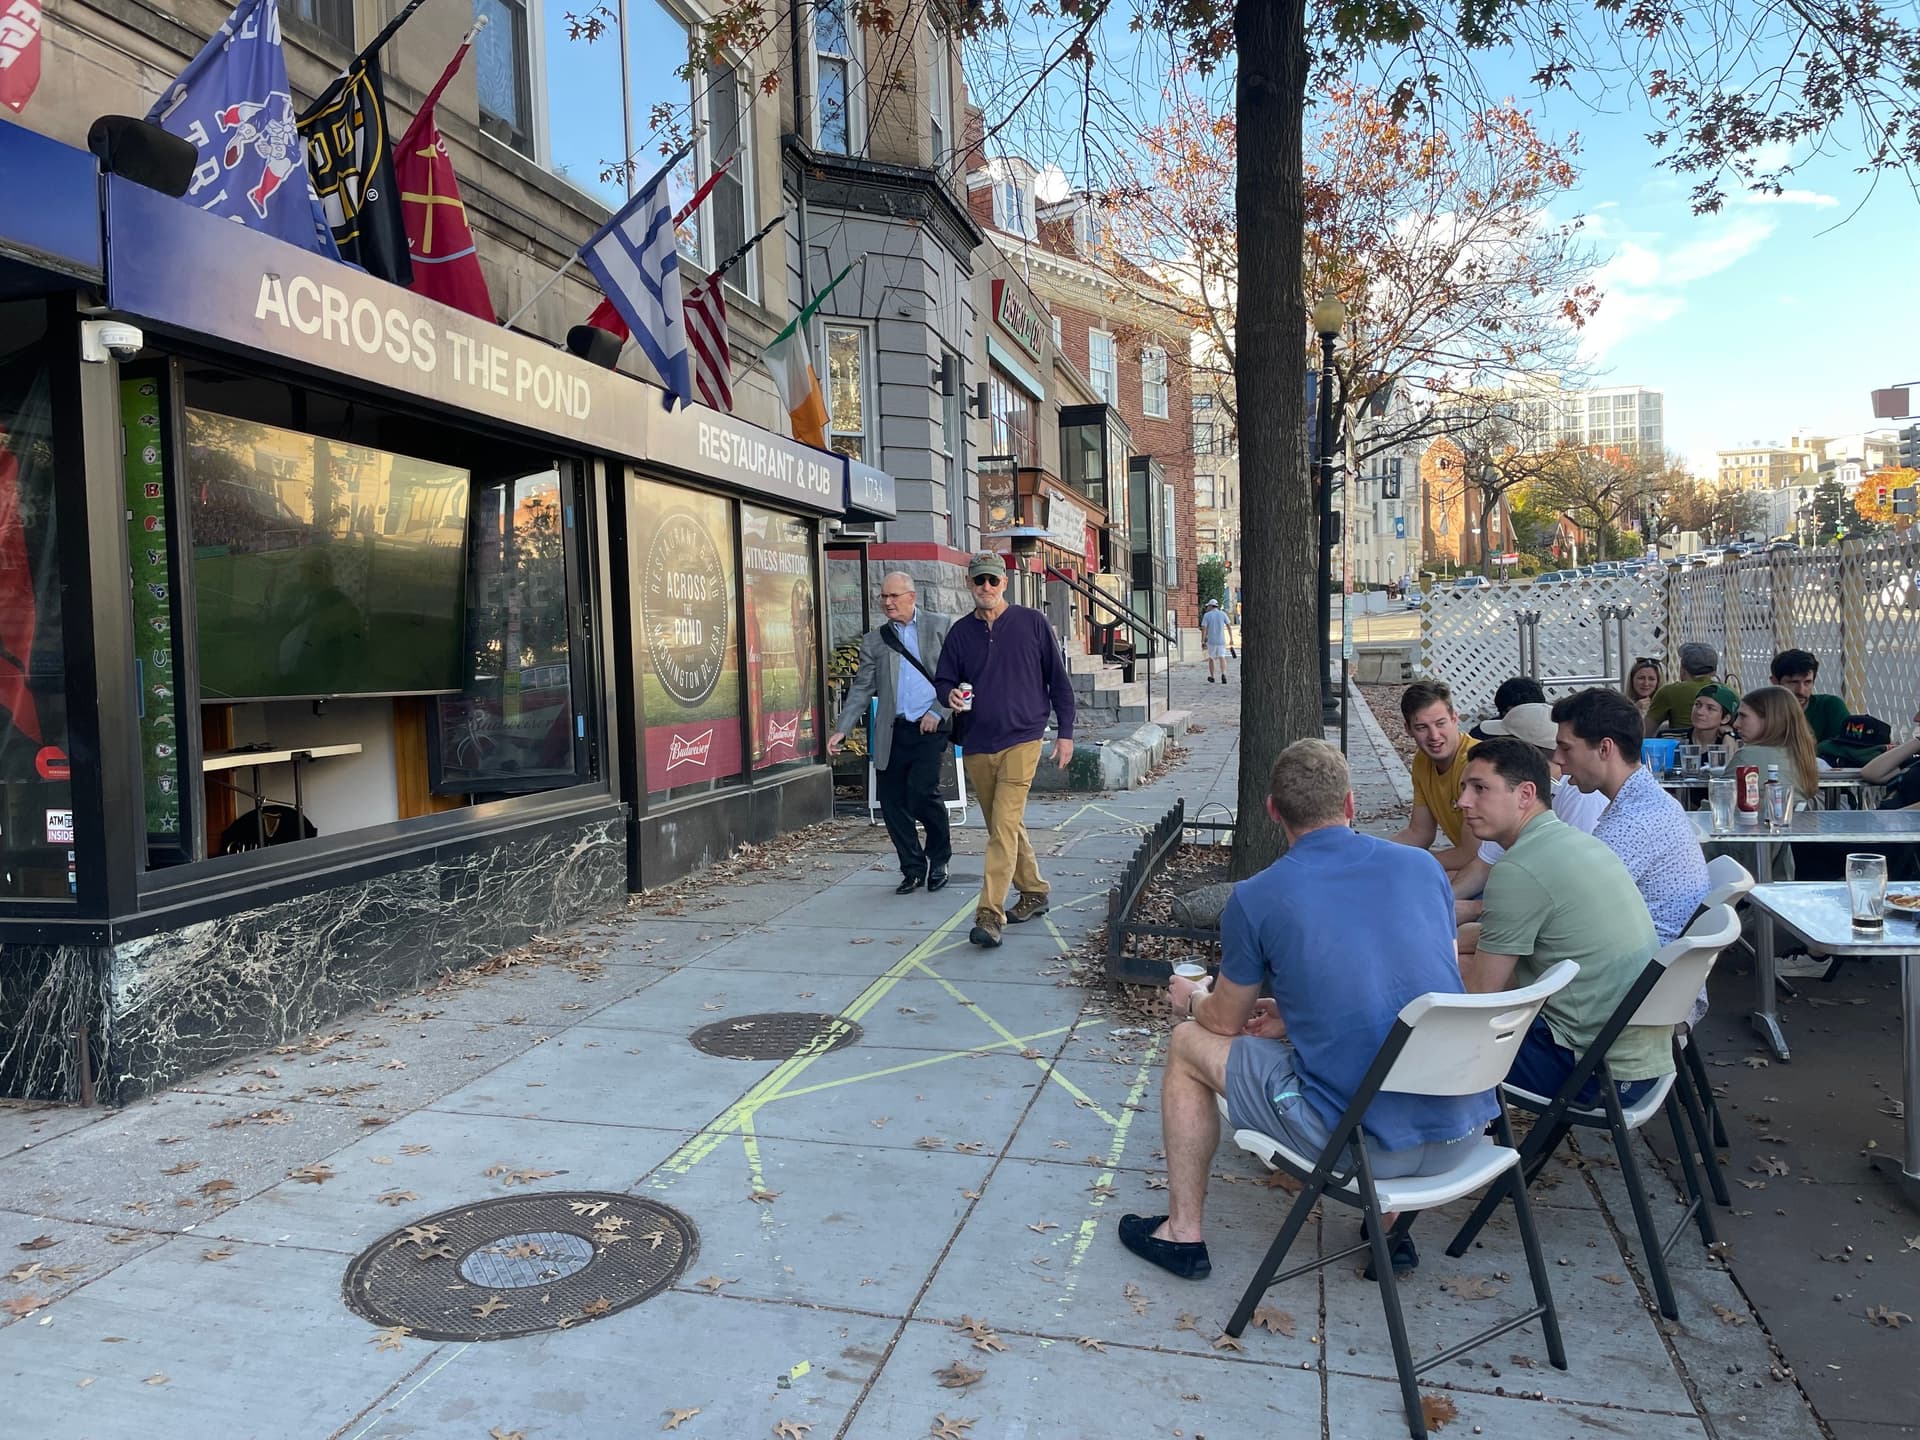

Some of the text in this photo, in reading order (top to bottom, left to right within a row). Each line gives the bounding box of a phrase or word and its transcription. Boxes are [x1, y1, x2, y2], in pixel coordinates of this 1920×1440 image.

[255, 272, 592, 420] ACROSS THE POND
[699, 422, 832, 496] RESTAURANT & PUB
[864, 476, 884, 503] 1734
[651, 527, 697, 594] RESTAURANT
[705, 562, 720, 597] PUB
[744, 546, 809, 576] WITNESS HISTORY
[667, 571, 706, 602] ACROSS
[683, 603, 693, 616] THE
[674, 618, 703, 646] POND
[654, 623, 700, 689] WASHINGTON
[709, 625, 721, 656] USA
[670, 742, 710, 760] Budweiser
[49, 816, 64, 826] ATM
[48, 831, 74, 841] INSIDE
